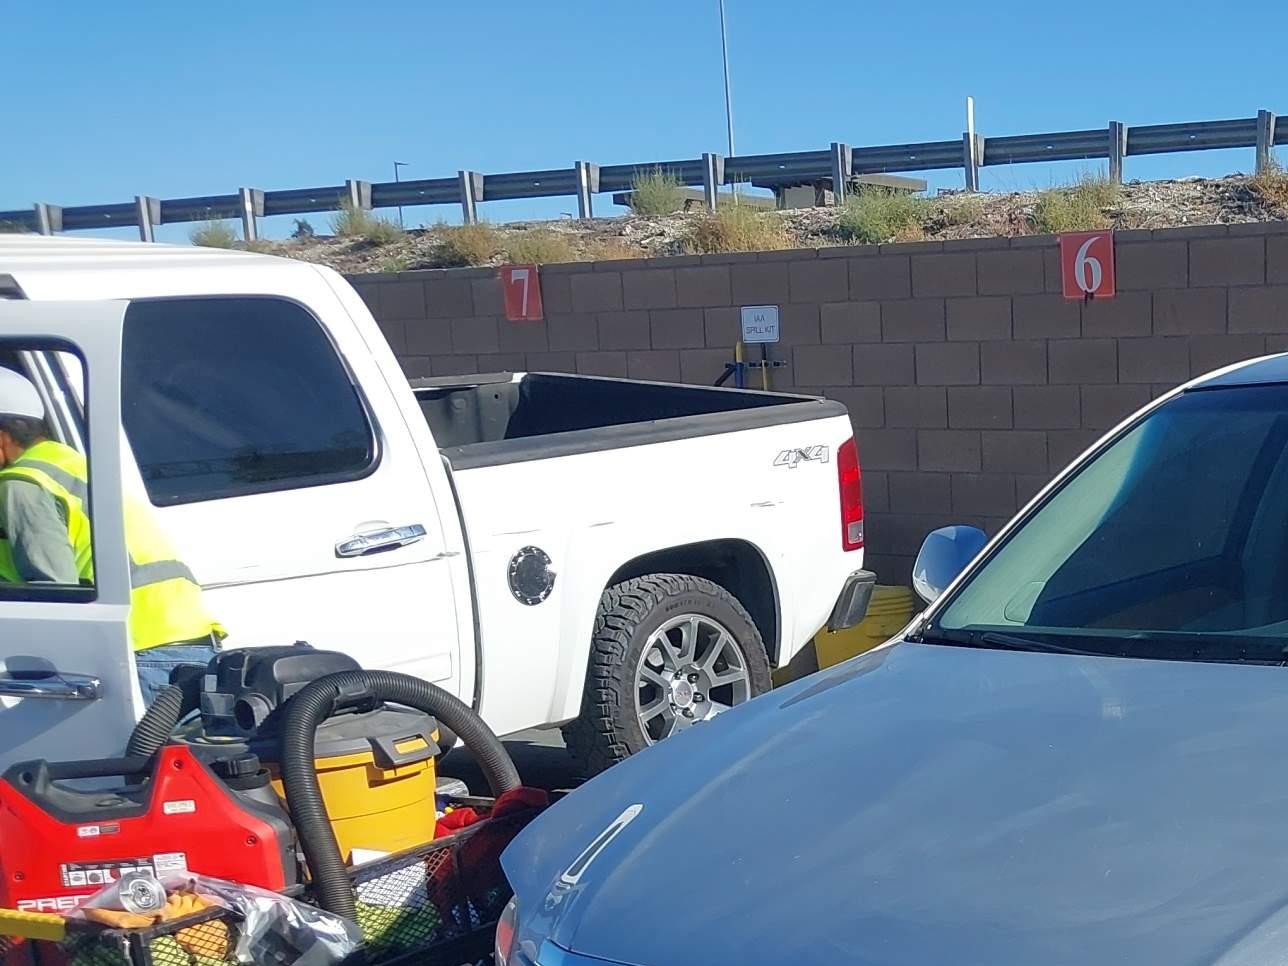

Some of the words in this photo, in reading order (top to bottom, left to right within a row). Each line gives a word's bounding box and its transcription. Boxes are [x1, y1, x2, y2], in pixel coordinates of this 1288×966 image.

[1074, 235, 1104, 293] 6
[511, 268, 529, 317] 7
[745, 326, 764, 334] SPILL
[765, 325, 776, 333] KIT
